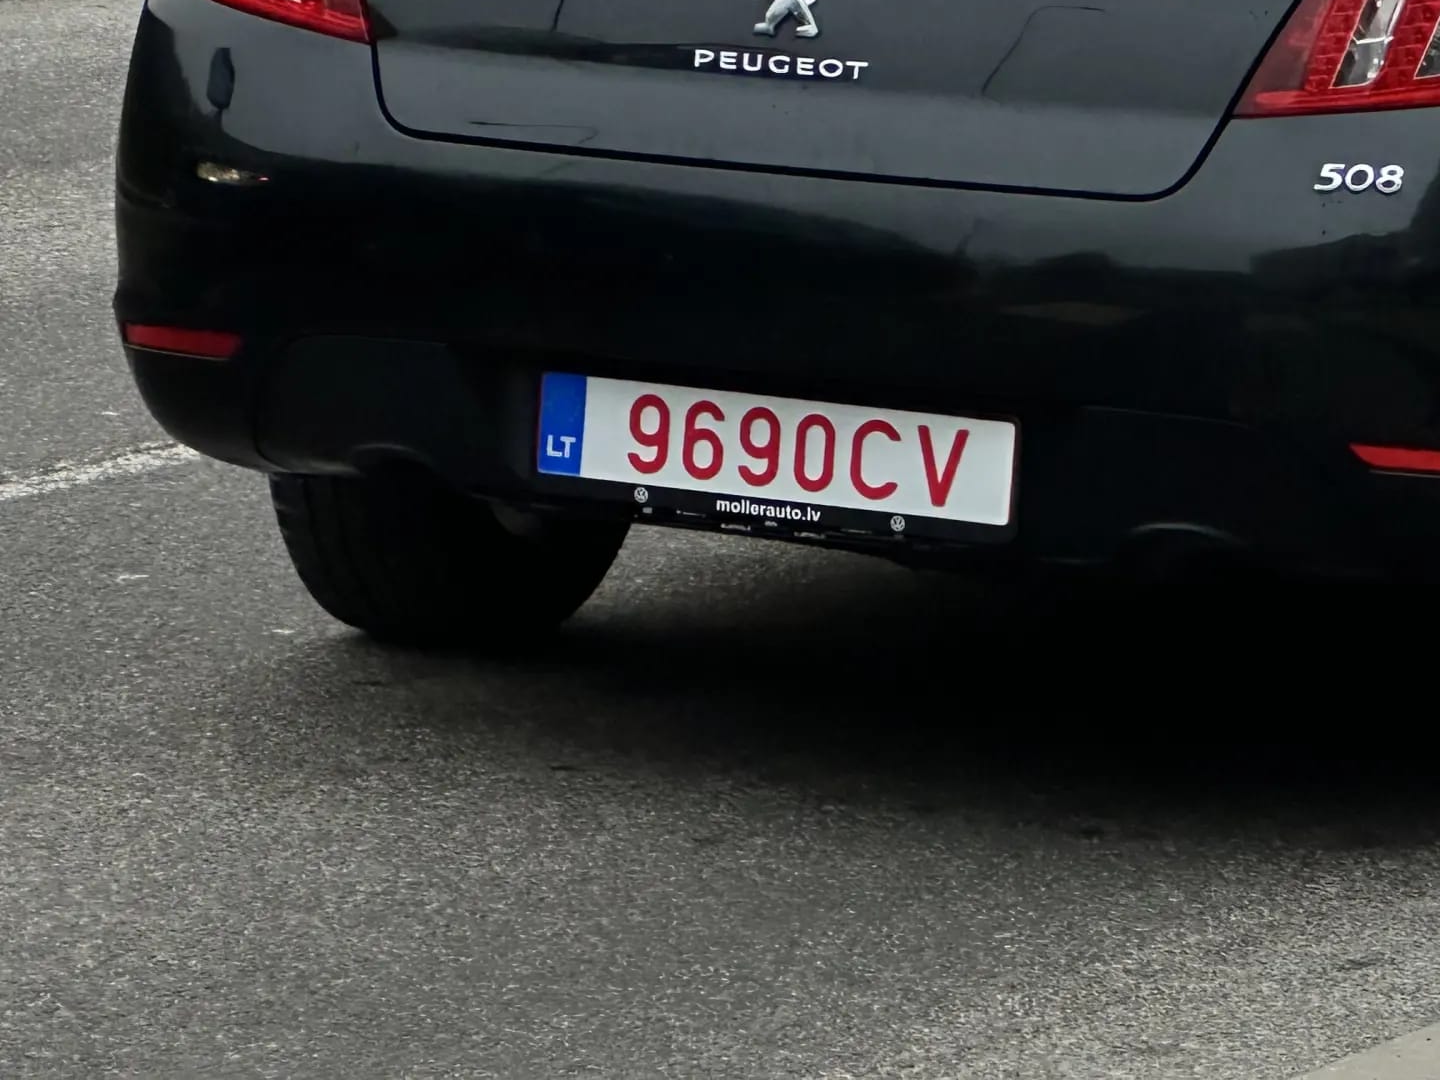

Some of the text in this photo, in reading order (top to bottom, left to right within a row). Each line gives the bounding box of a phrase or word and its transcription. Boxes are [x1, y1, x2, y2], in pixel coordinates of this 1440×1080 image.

[694, 49, 869, 79] PEUGEOT
[1313, 163, 1405, 194] 508
[546, 434, 576, 459] LT
[627, 394, 970, 508] 9690CV
[716, 498, 821, 522] mollerauto.lv
